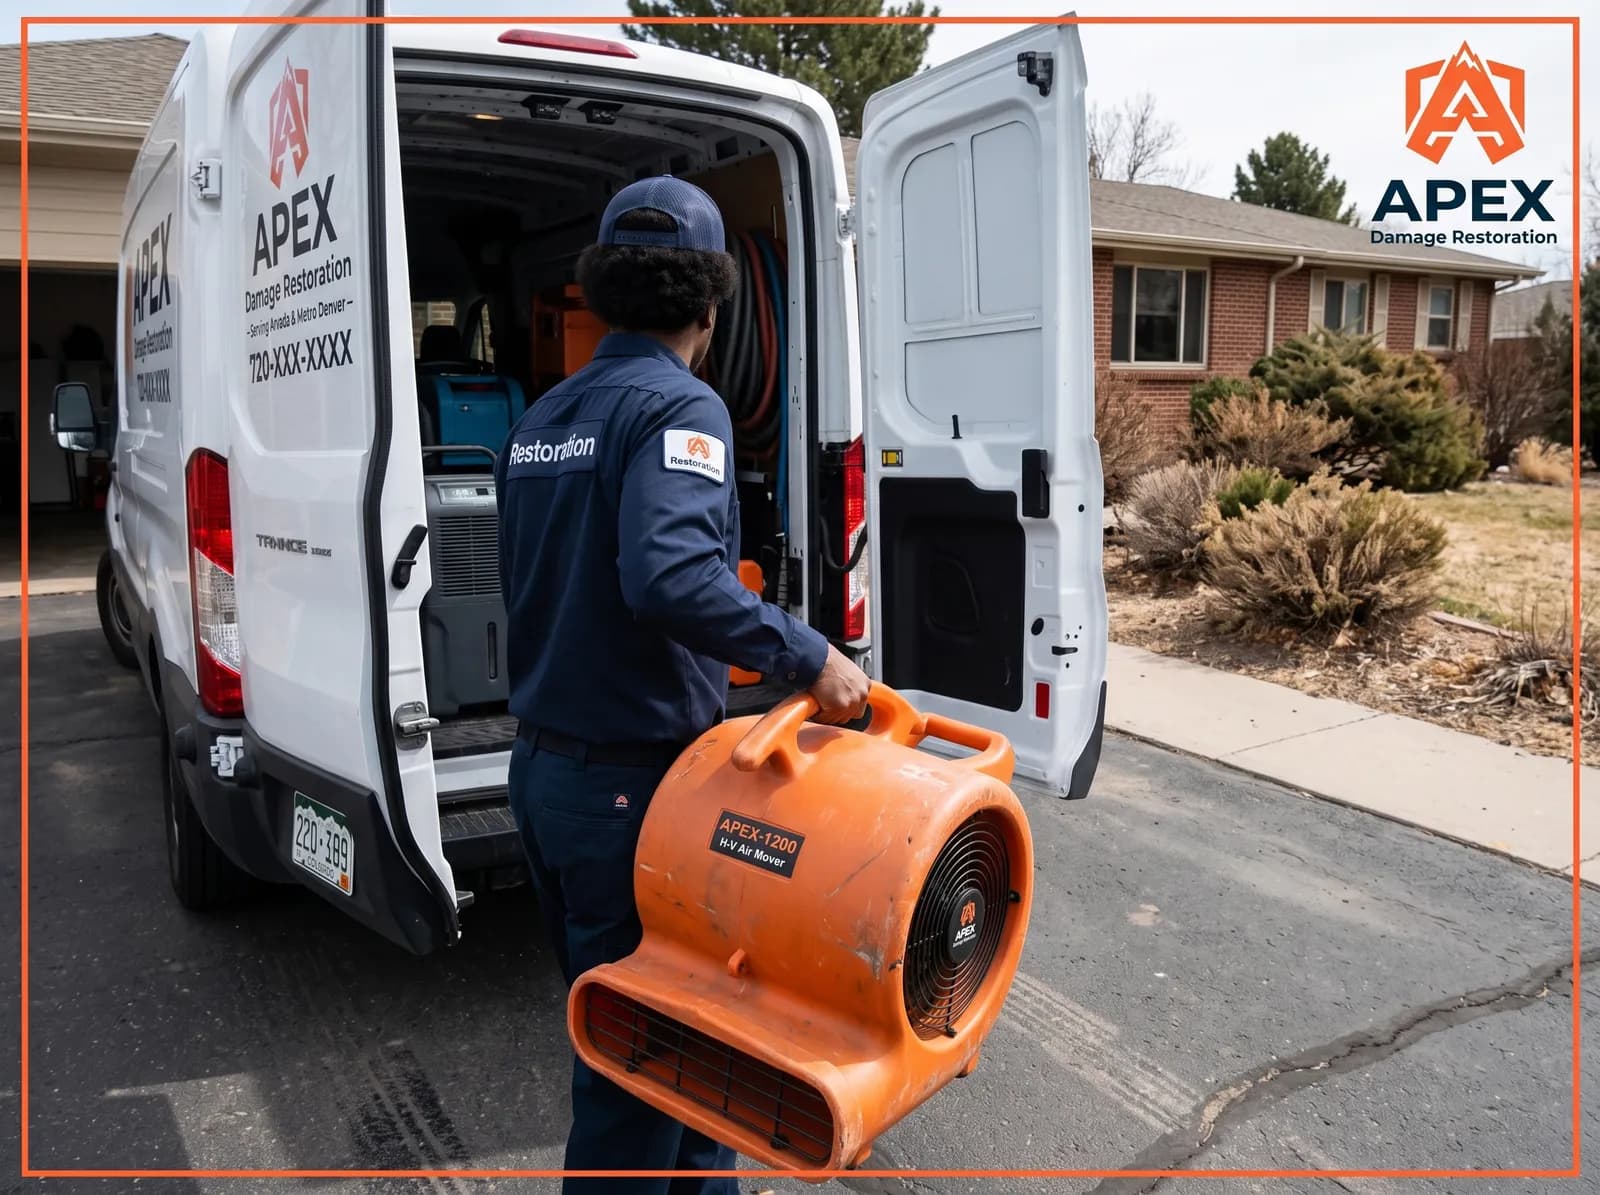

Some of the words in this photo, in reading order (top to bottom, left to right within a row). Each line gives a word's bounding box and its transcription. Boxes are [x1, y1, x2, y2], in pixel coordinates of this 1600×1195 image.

[252, 174, 337, 276] APEX
[134, 212, 172, 327] APEX
[245, 283, 281, 313] Damage
[283, 254, 352, 299] Restoration
[270, 312, 290, 332] Arvada
[297, 307, 317, 324] Metro
[318, 299, 346, 318] Denver
[249, 329, 353, 384] 720-XXX-XXXX
[509, 434, 595, 466] Restoration
[670, 456, 720, 476] Restoration
[720, 818, 797, 854] APEX-1200
[720, 837, 737, 850] H-V
[738, 844, 753, 856] Air
[754, 849, 786, 868] Mover
[955, 923, 976, 941] APEX
